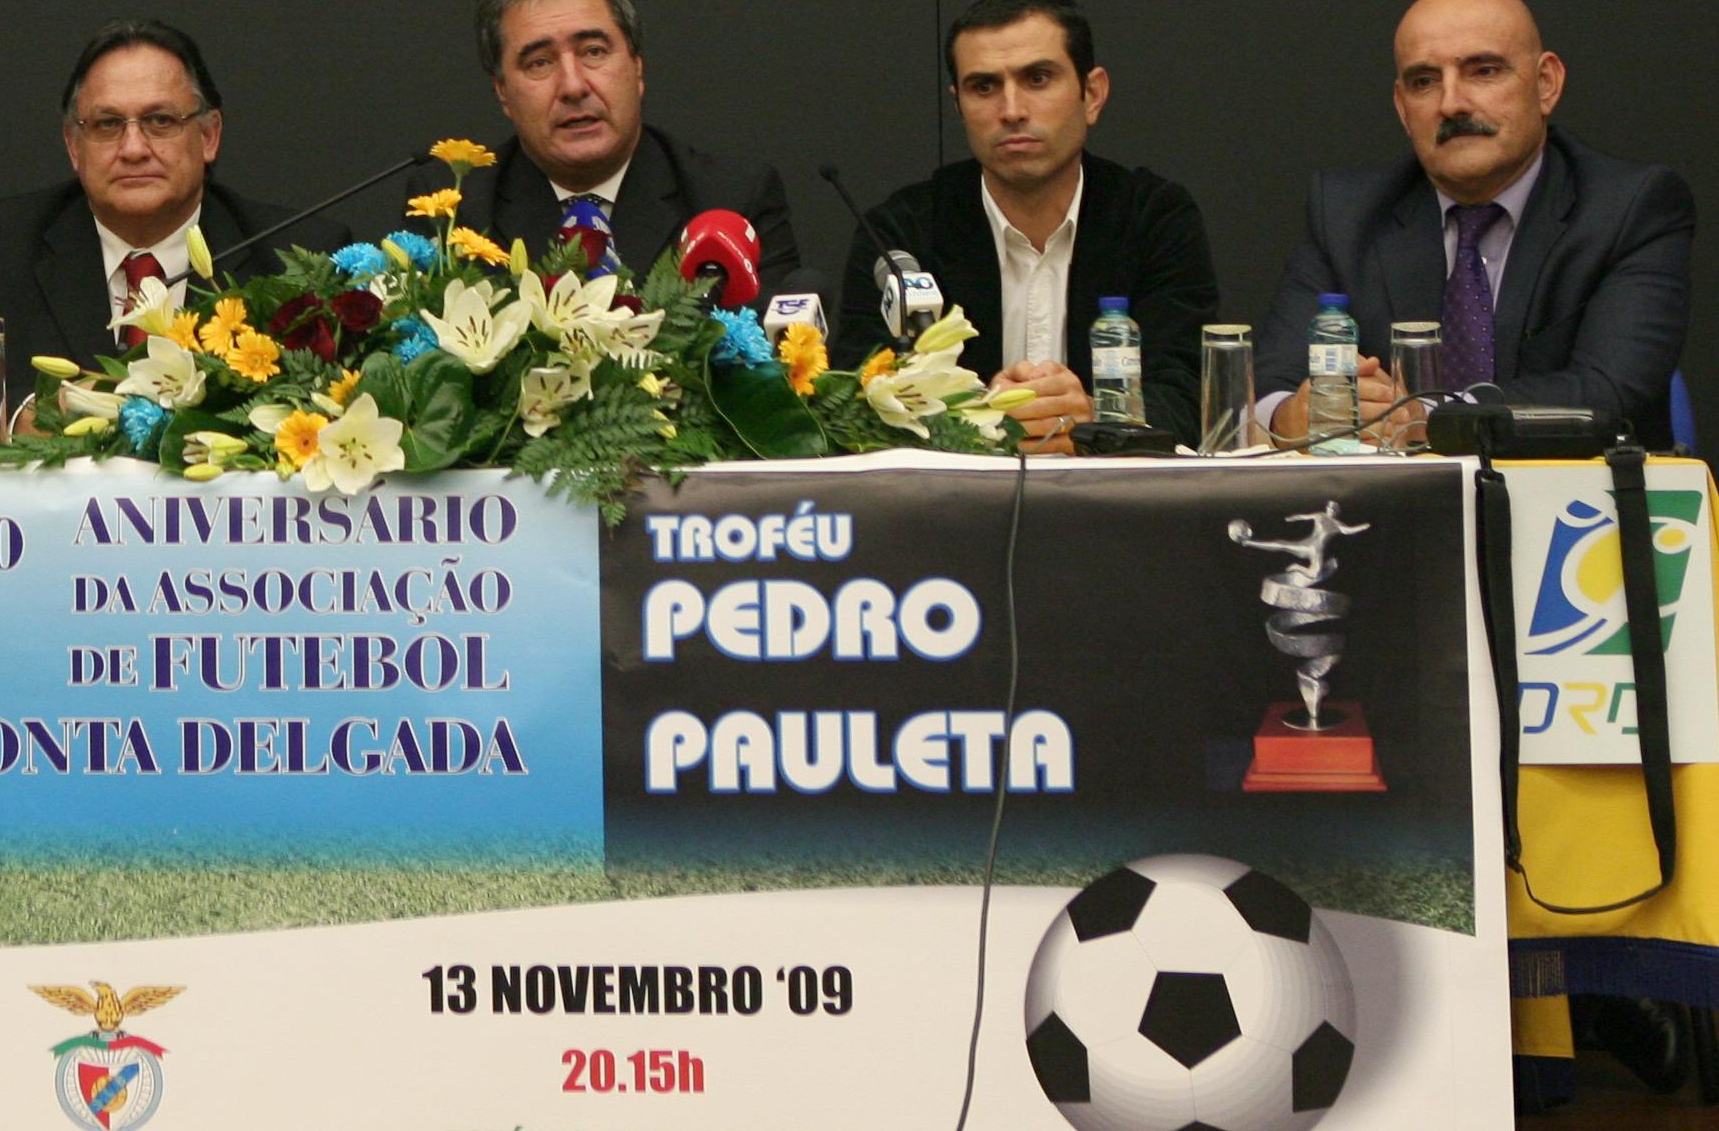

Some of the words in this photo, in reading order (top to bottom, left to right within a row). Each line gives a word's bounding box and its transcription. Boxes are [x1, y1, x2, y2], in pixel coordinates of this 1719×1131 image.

[73, 481, 519, 548] ANIVERSÁRIO
[645, 500, 853, 562] TROFÉU
[71, 574, 139, 615] DA
[148, 555, 514, 626] ASSOCIAÇÃO
[642, 577, 981, 662] PEDRO
[67, 646, 139, 687] DE
[148, 634, 511, 692] FUTEBOL
[177, 717, 528, 776] DELGADA
[644, 709, 1075, 794] PAULETA
[421, 964, 479, 1016] 13
[491, 964, 762, 1016] NOVEMBRO
[560, 1047, 705, 1094] 20.15h
